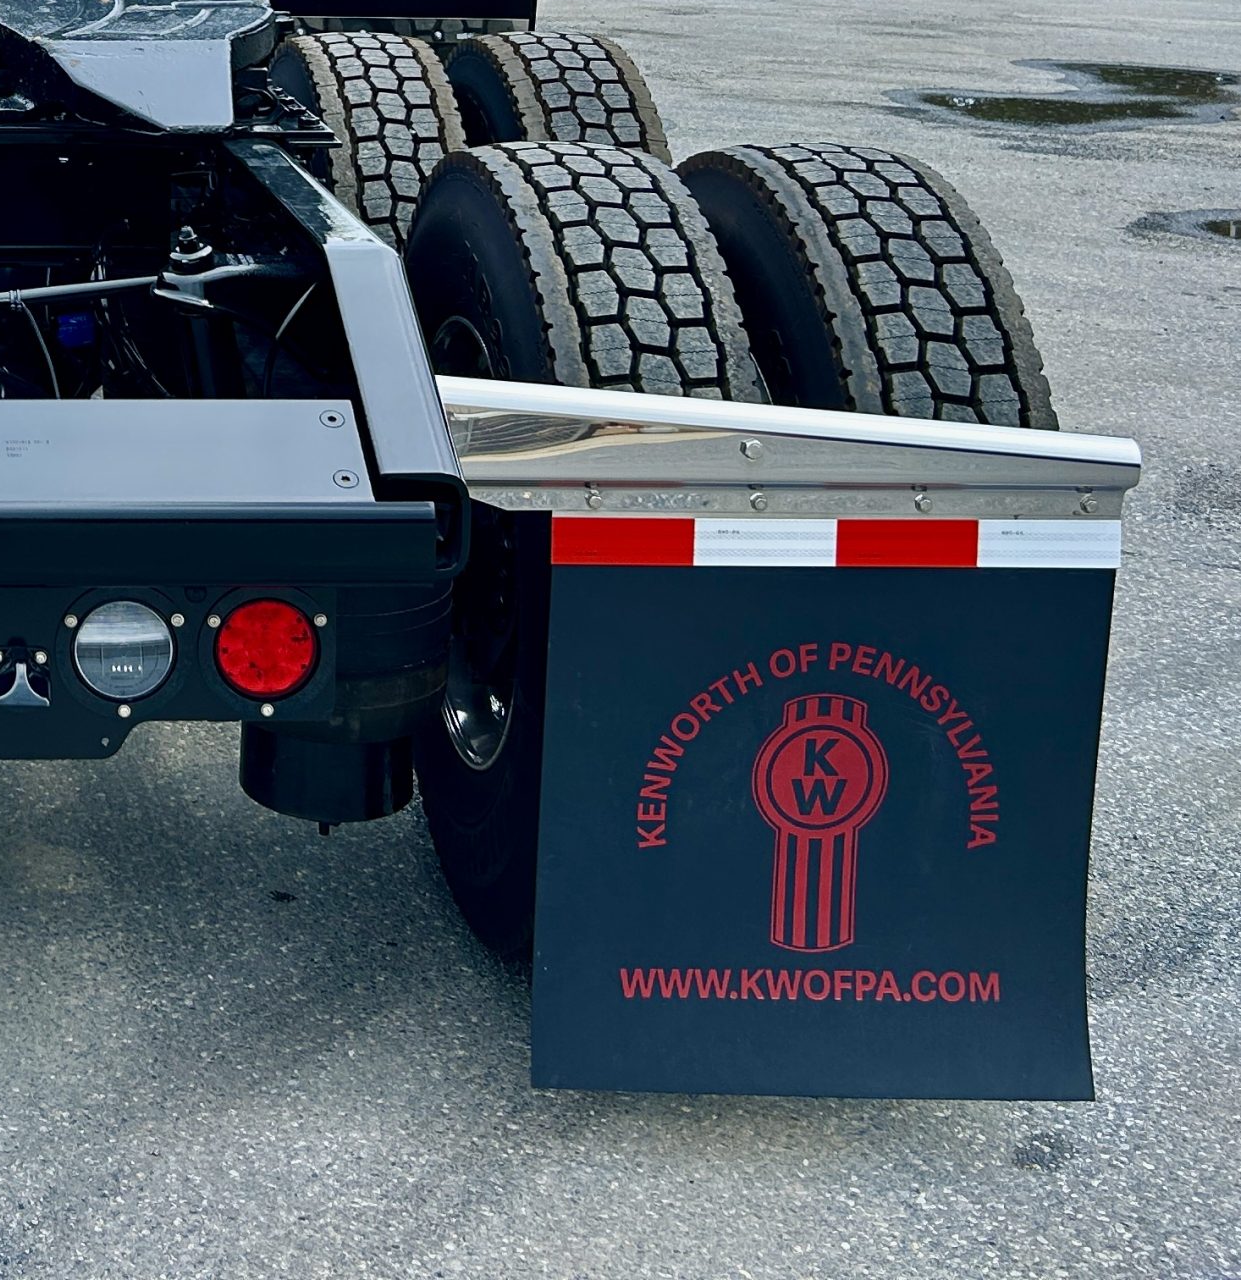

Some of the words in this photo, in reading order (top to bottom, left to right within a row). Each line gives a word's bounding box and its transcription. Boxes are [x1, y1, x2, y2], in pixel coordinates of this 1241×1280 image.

[637, 663, 761, 848] KENWORTH
[769, 643, 817, 677] OF
[829, 642, 999, 851] PENNSYLVANIA
[620, 968, 1001, 1004] WWW.KWOFPA.COM
